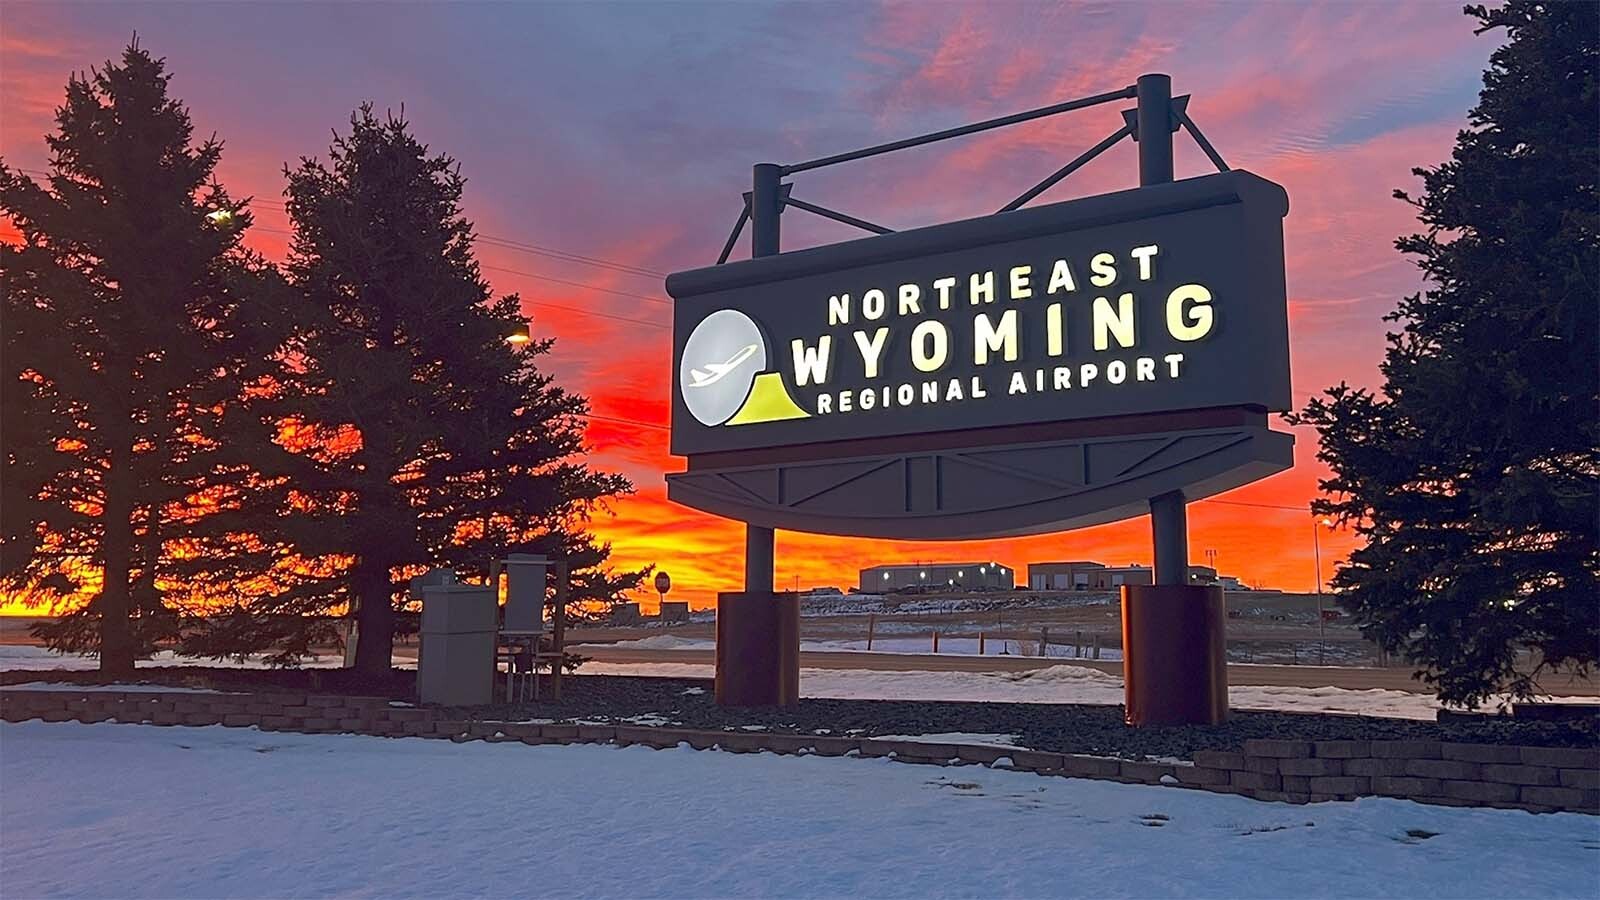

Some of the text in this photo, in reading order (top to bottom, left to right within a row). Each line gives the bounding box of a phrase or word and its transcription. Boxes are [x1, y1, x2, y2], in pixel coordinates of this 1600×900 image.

[828, 244, 1160, 326] NORTHEAST
[791, 284, 1214, 387] WYOMING
[817, 353, 1185, 415] REGIONAL AIRPORT
